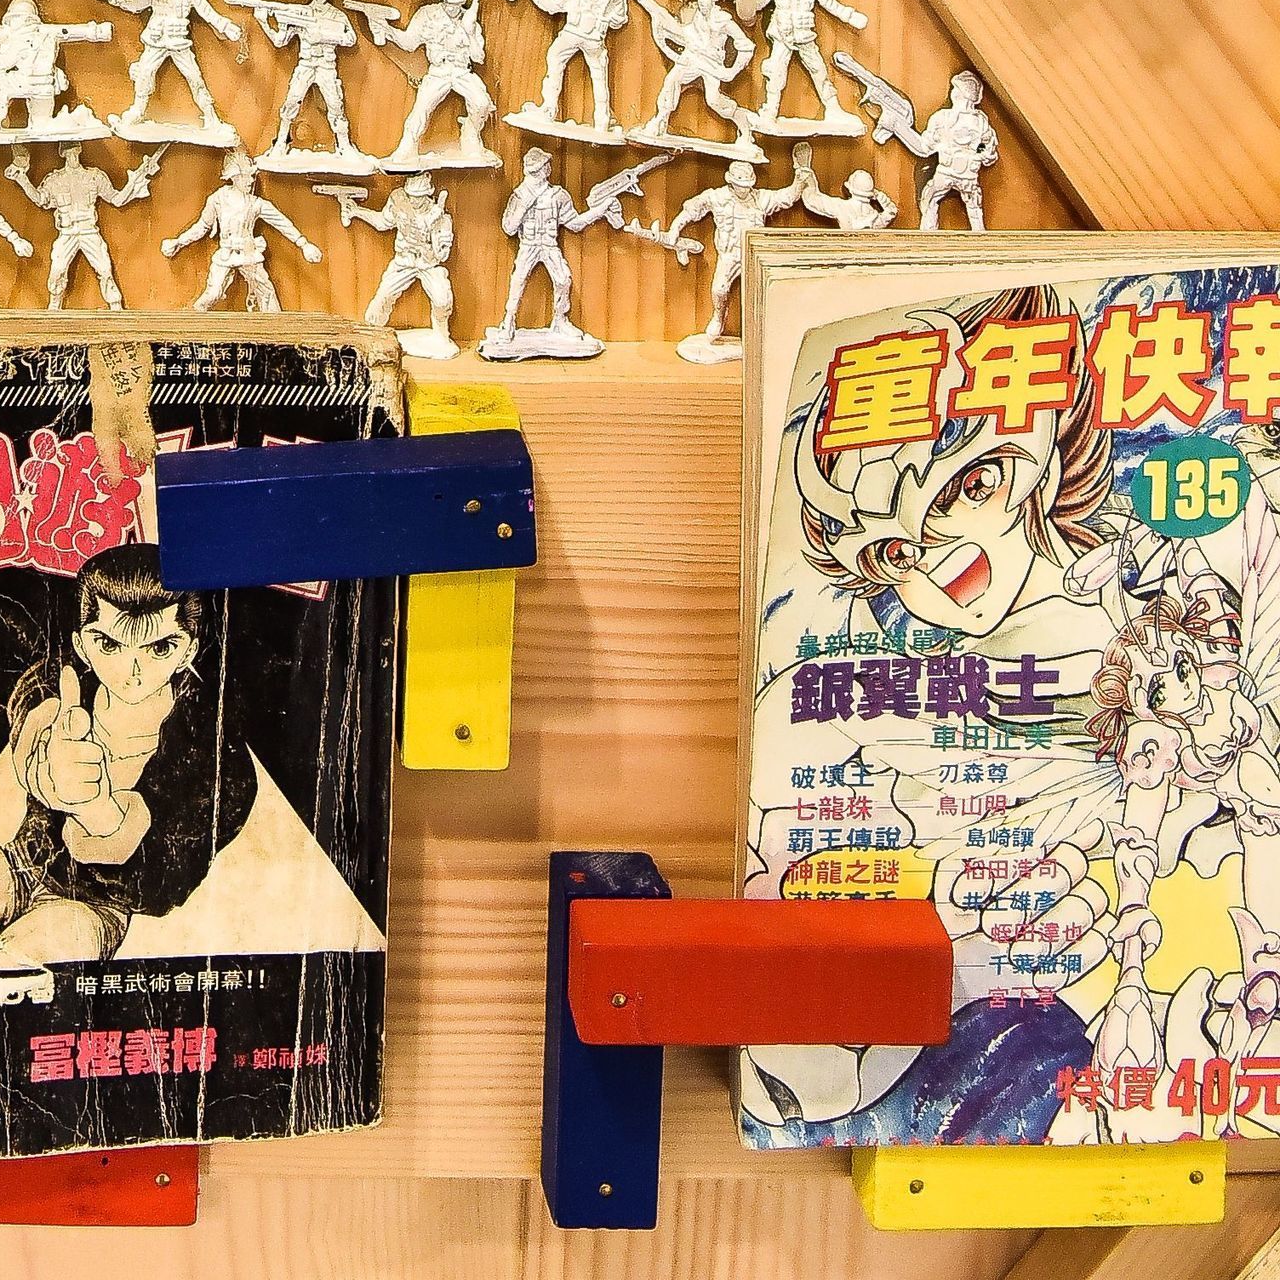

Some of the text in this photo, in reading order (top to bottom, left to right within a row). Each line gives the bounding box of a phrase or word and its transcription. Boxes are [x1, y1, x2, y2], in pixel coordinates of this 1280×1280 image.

[1143, 458, 1240, 522] 135
[796, 628, 964, 659] 最新超強單元
[791, 654, 1059, 724] 銀翼戰士
[930, 725, 1053, 751] 車田正美
[791, 763, 1008, 789] 破壞王 刃森尊
[793, 795, 1007, 821] 七龍珠 鳥山明
[787, 859, 899, 885] 神龍之謎
[76, 969, 265, 996] 暗黑武術會開幕!!
